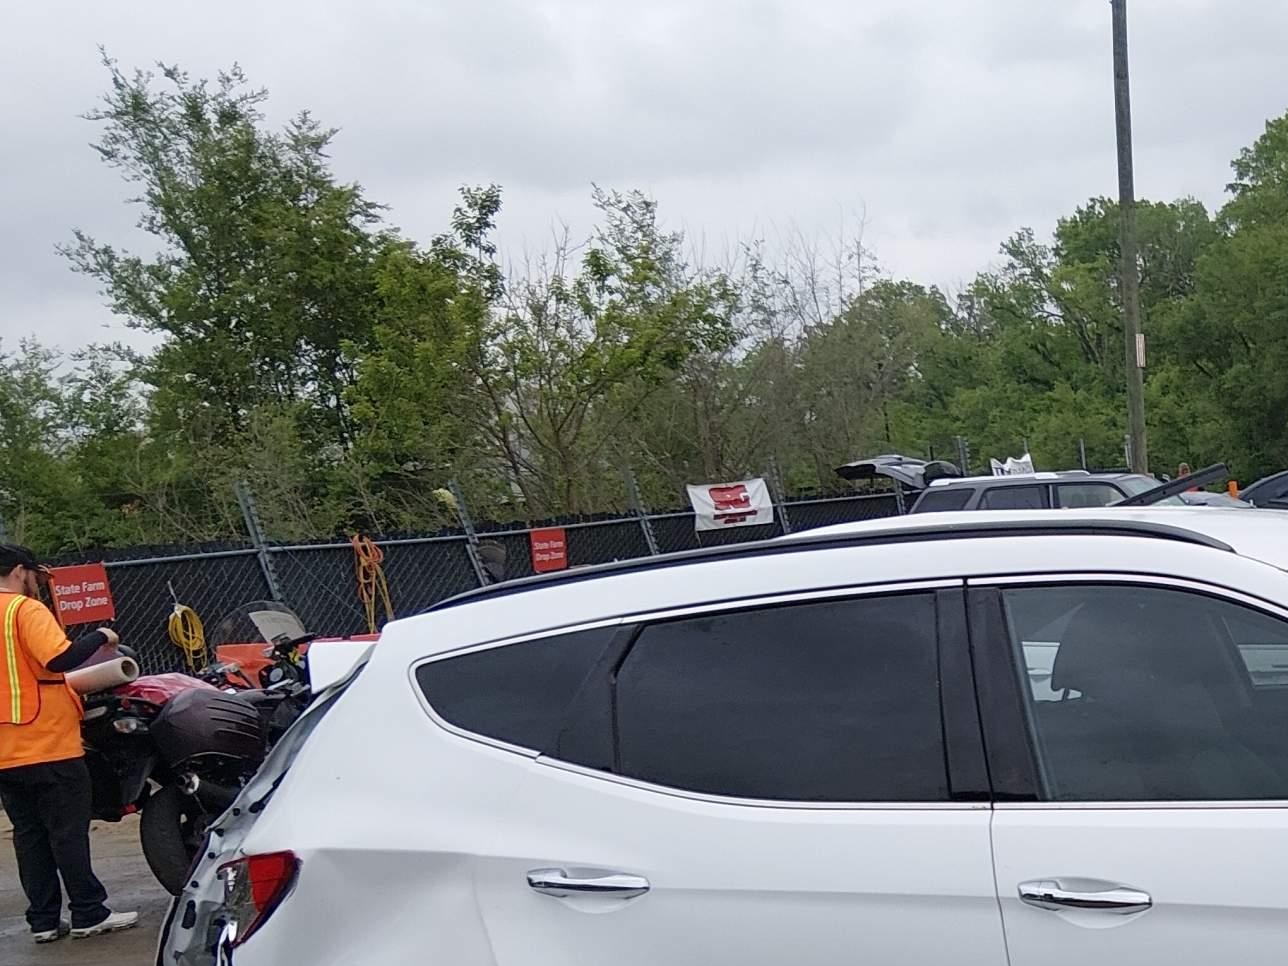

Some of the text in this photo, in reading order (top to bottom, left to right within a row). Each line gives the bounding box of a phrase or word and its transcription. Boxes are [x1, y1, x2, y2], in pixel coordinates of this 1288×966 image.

[55, 582, 105, 596] State Farm
[60, 597, 108, 611] Drop Zone
